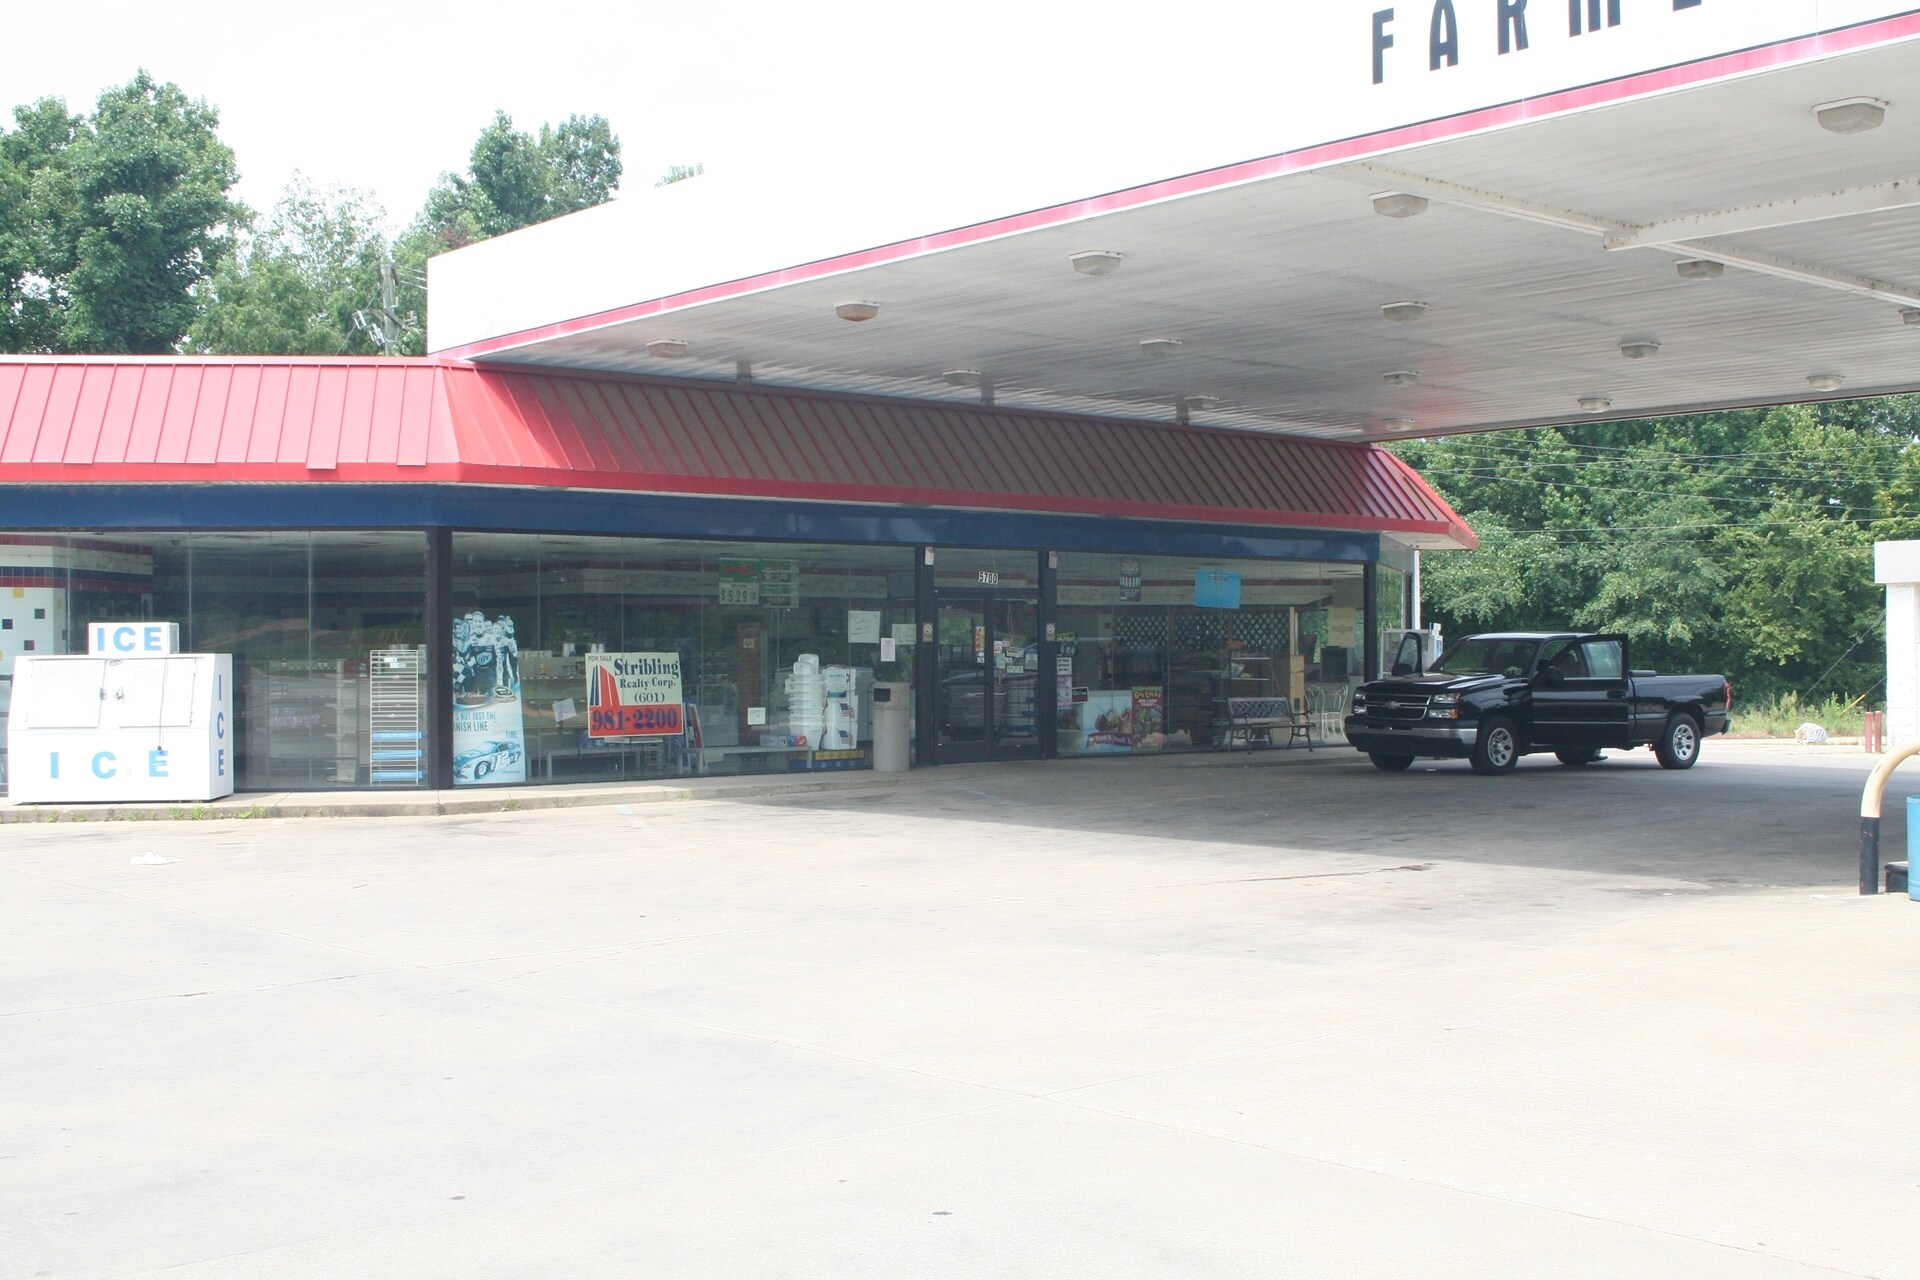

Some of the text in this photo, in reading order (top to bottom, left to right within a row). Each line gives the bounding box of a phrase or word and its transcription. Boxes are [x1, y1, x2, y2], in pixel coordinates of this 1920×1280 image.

[979, 572, 997, 584] 5700
[97, 626, 162, 652] ICE
[614, 658, 679, 680] Stribling
[619, 677, 676, 690] Realty Corp.
[634, 692, 665, 704] (601)
[485, 711, 497, 720] THE
[592, 708, 678, 731] 981-2200
[217, 674, 225, 777] ICE
[473, 721, 488, 731] LINE
[49, 750, 169, 779] ICE
